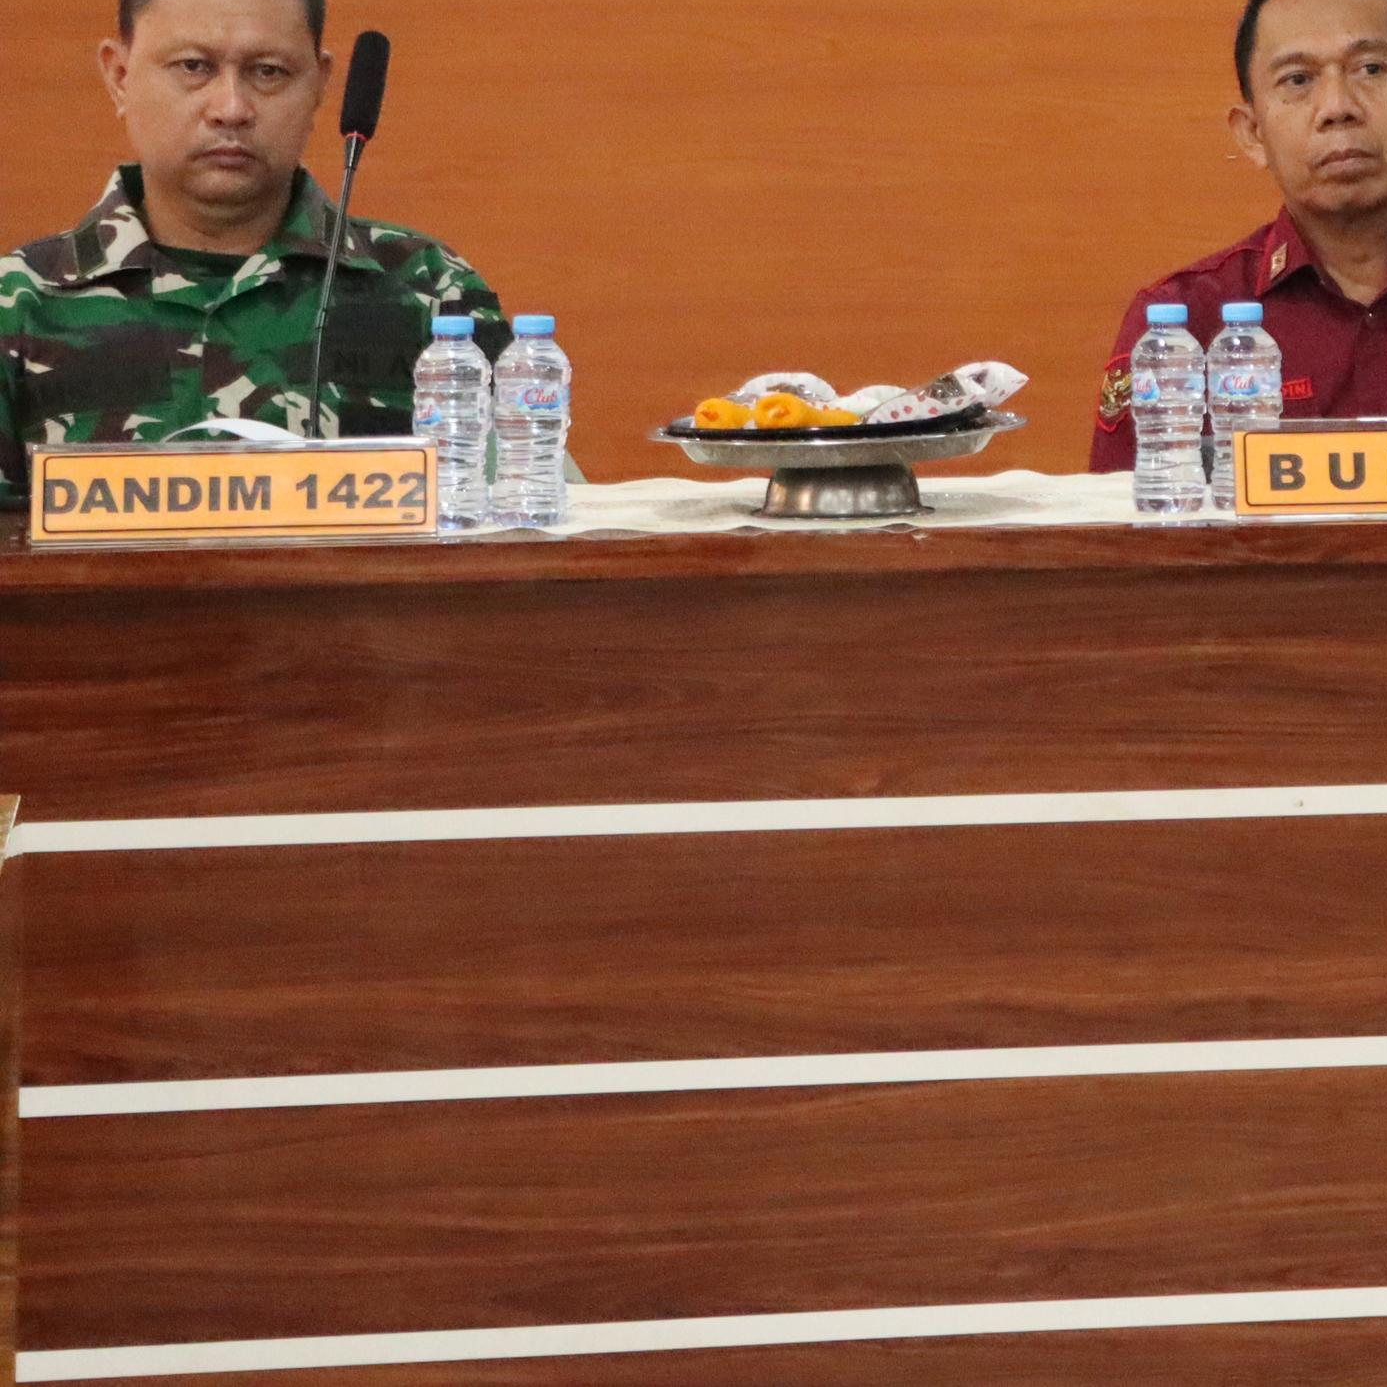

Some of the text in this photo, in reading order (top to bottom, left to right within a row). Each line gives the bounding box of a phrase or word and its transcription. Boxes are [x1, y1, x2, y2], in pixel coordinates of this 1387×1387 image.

[1223, 373, 1256, 390] Club
[524, 388, 558, 405] Club
[44, 472, 426, 514] DANDIM 1422
